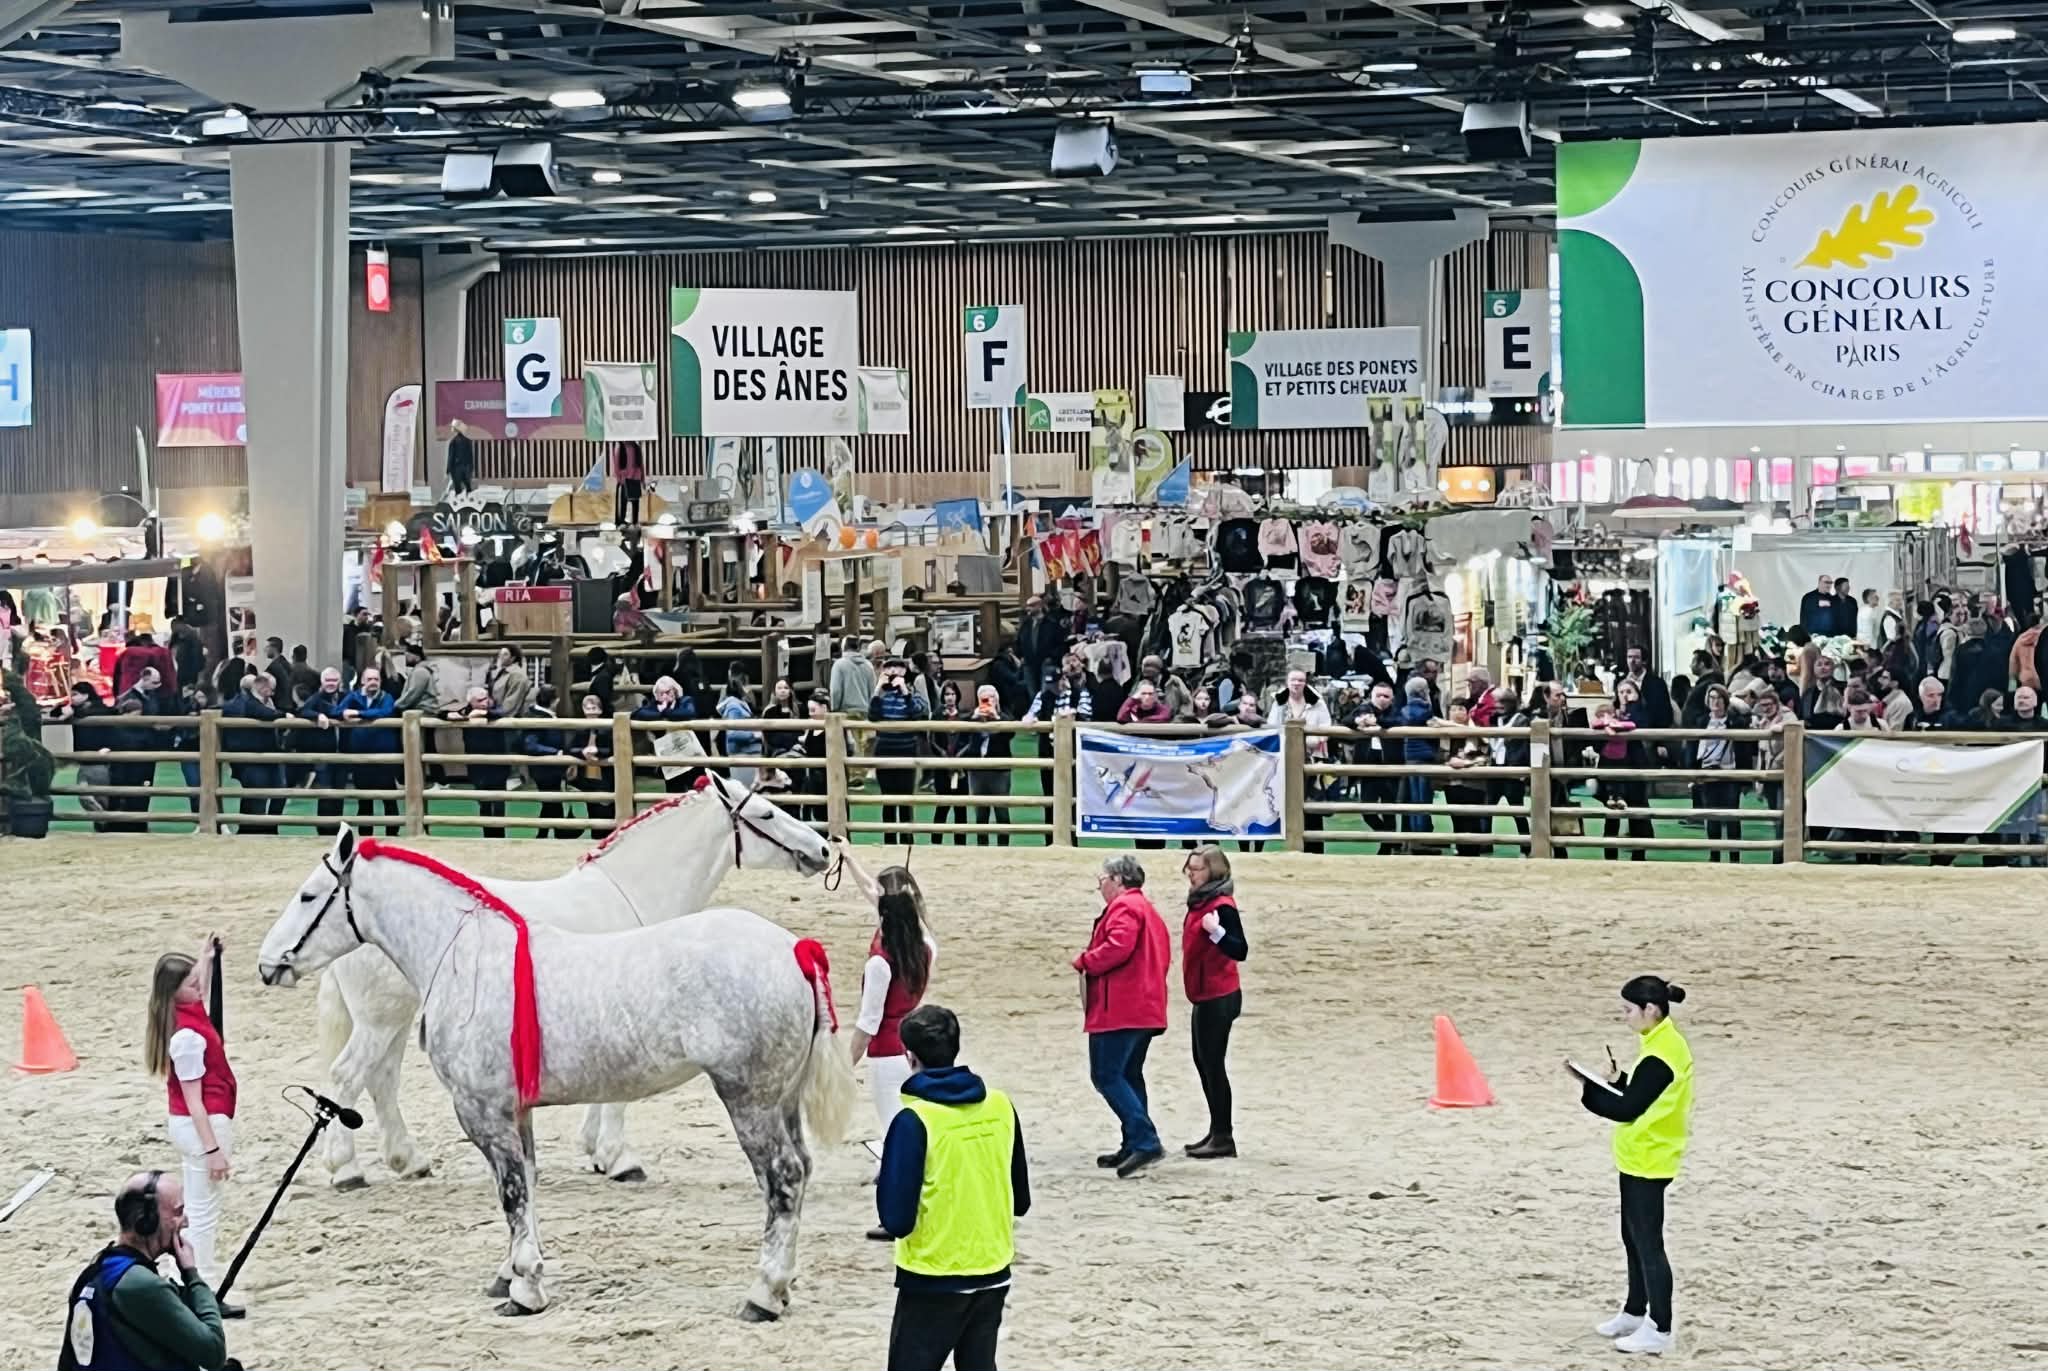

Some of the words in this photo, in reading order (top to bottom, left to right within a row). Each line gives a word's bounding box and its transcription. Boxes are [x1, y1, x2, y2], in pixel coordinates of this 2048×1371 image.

[1751, 167, 1826, 243] CONCOURS
[1765, 275, 1970, 303] CONCOURS
[973, 314, 986, 332] 6
[1493, 299, 1507, 317] 6
[1783, 301, 1953, 334] GÉNÉRAL
[512, 326, 525, 344] 6
[712, 325, 824, 358] VILLAGE
[1503, 326, 1532, 370] E
[1742, 264, 1784, 364] MINISTÈRE
[1784, 362, 1807, 382] EN
[1811, 379, 1886, 401] CHARGE
[1893, 382, 1917, 398] DE
[983, 340, 1008, 382] F
[1836, 336, 1901, 368] PARIS
[516, 352, 551, 392] G
[714, 369, 766, 401] DES
[775, 360, 848, 401] ÂNES
[1265, 361, 1322, 378] VILLAGE
[1328, 360, 1355, 376] DES
[1360, 359, 1418, 375] PONEYS
[1265, 381, 1282, 396] ET
[1287, 380, 1336, 396] PETITS
[1338, 378, 1407, 395] CHEVAUX
[432, 511, 507, 537] SALOON
[505, 589, 532, 601] RIA
